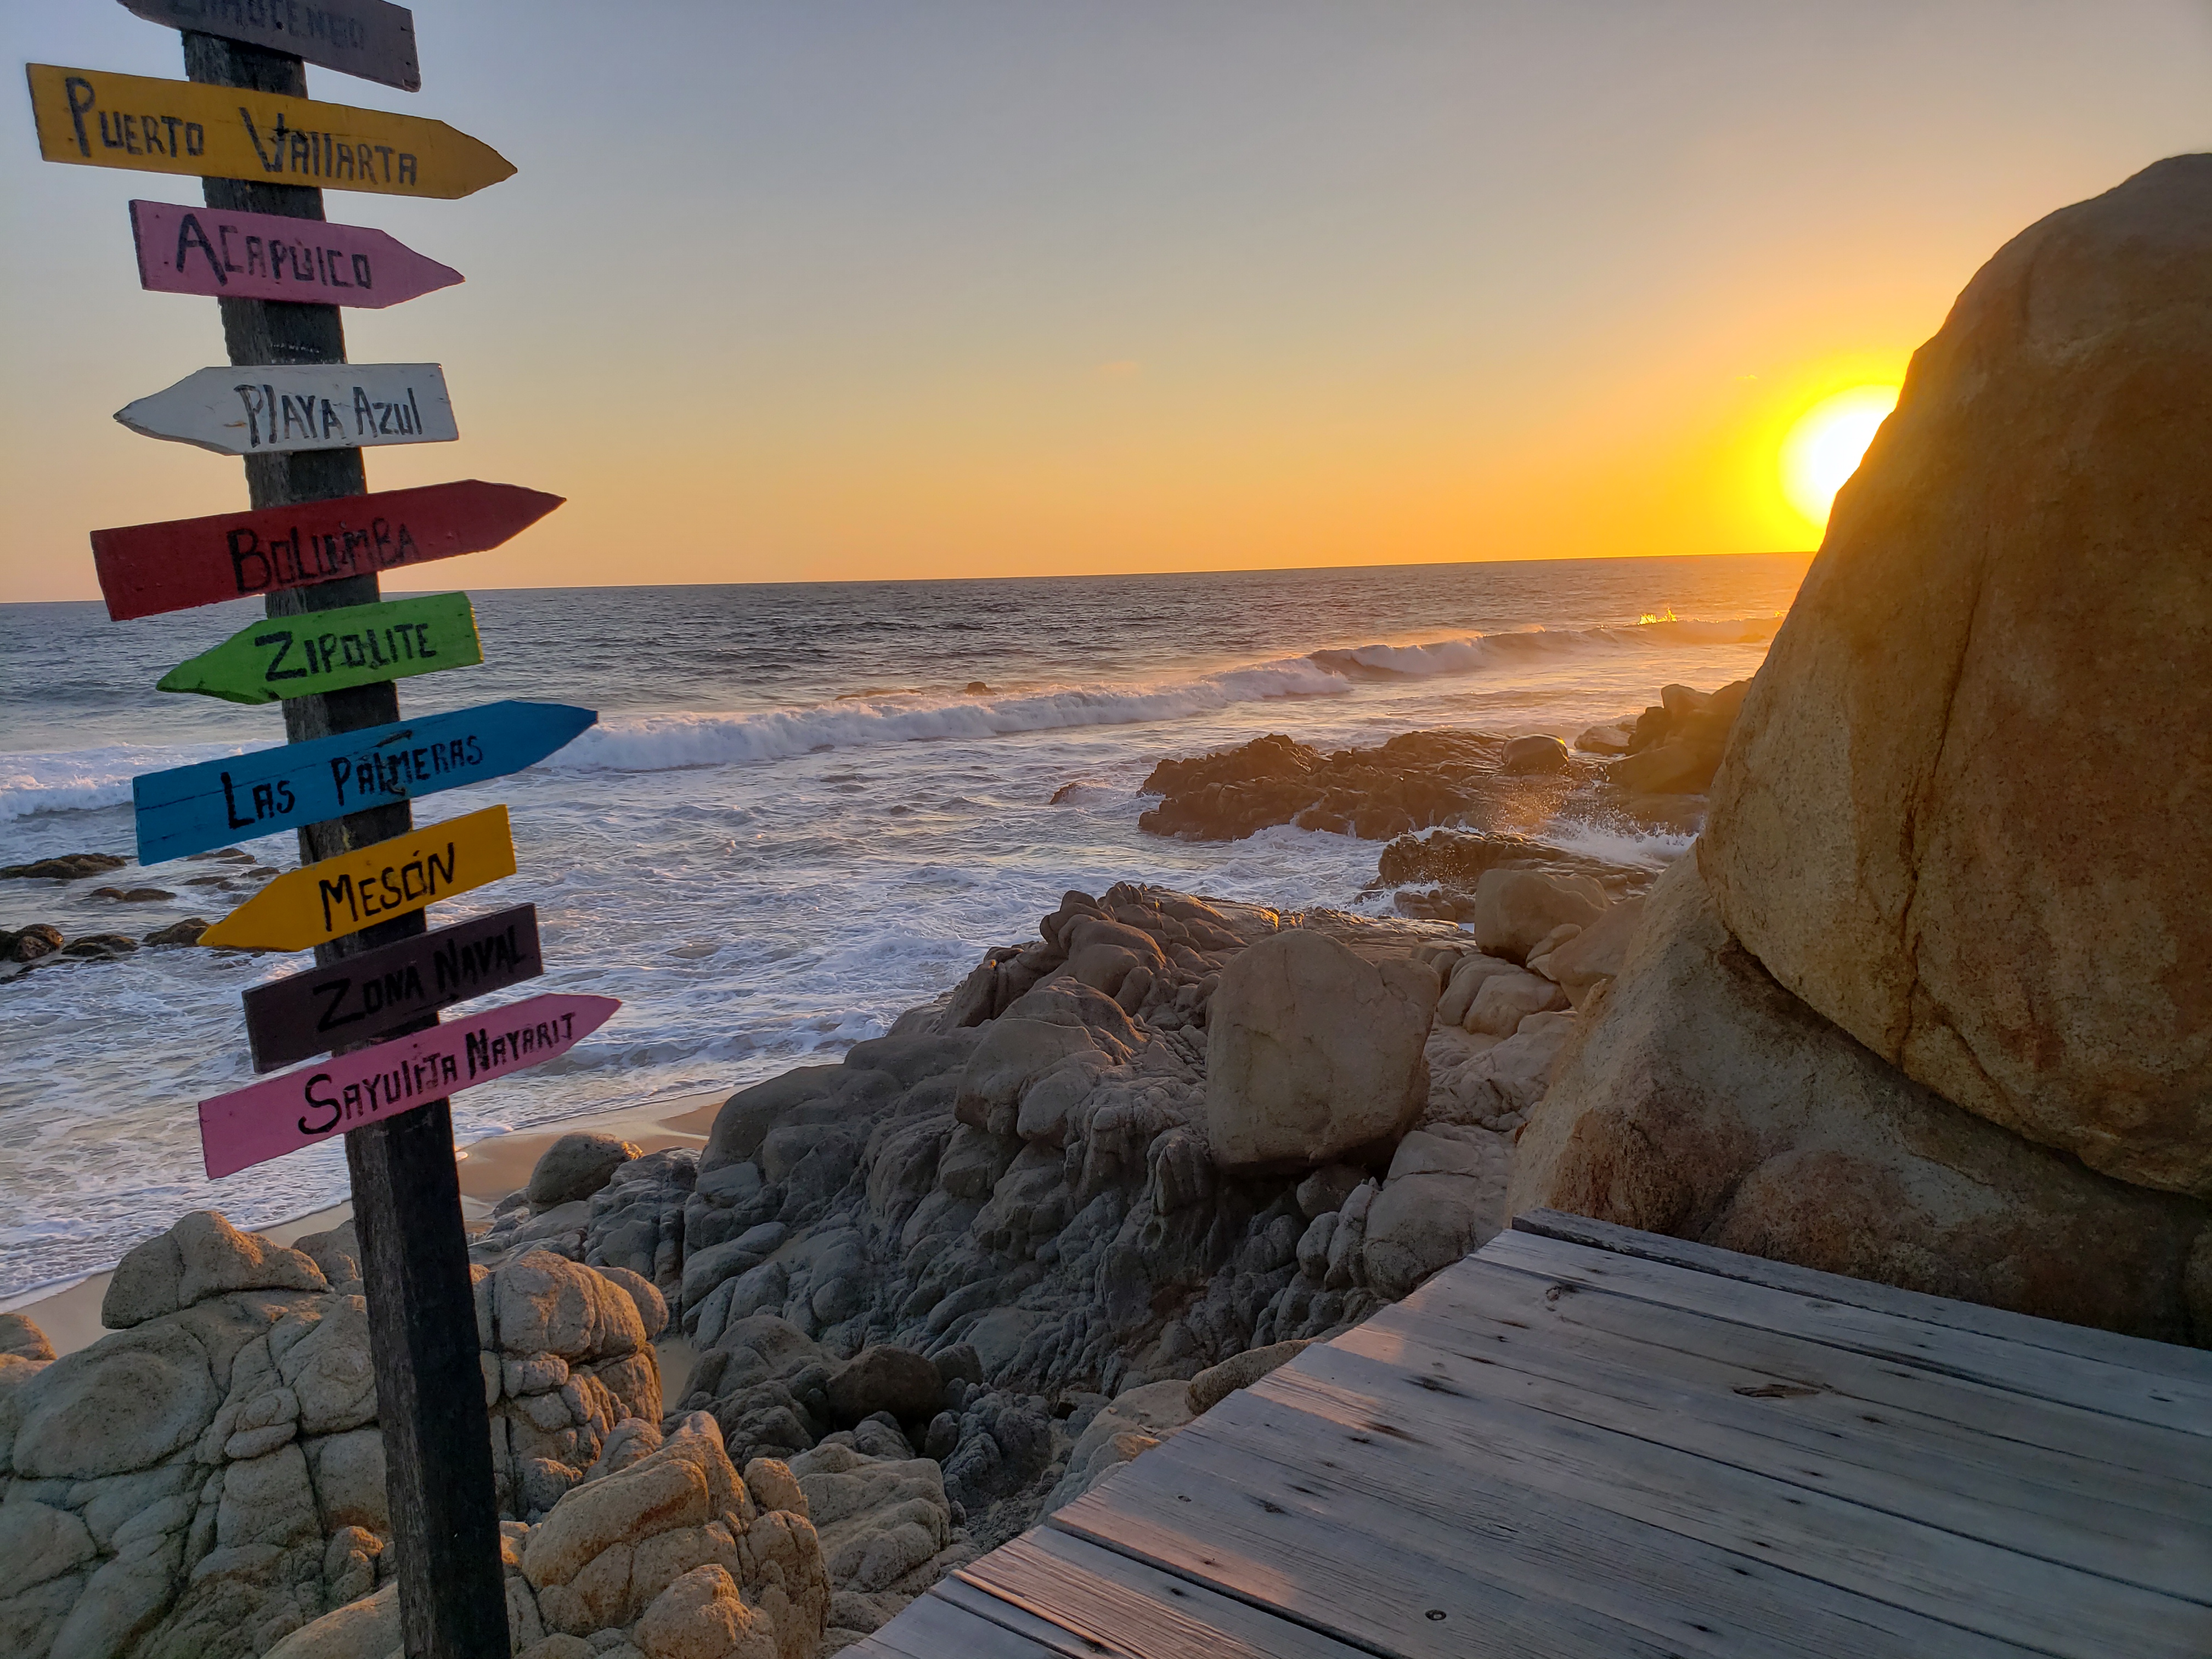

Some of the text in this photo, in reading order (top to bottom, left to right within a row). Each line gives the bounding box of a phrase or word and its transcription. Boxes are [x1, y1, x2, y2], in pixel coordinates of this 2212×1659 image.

[65, 77, 204, 157] PUERTO
[255, 623, 436, 682] ZIPOLITE
[221, 735, 483, 829] LAS PALMERAS
[319, 842, 455, 932] MESÓN
[313, 925, 527, 1032] ZONA NAVAL
[466, 1012, 575, 1080] NAYARIT
